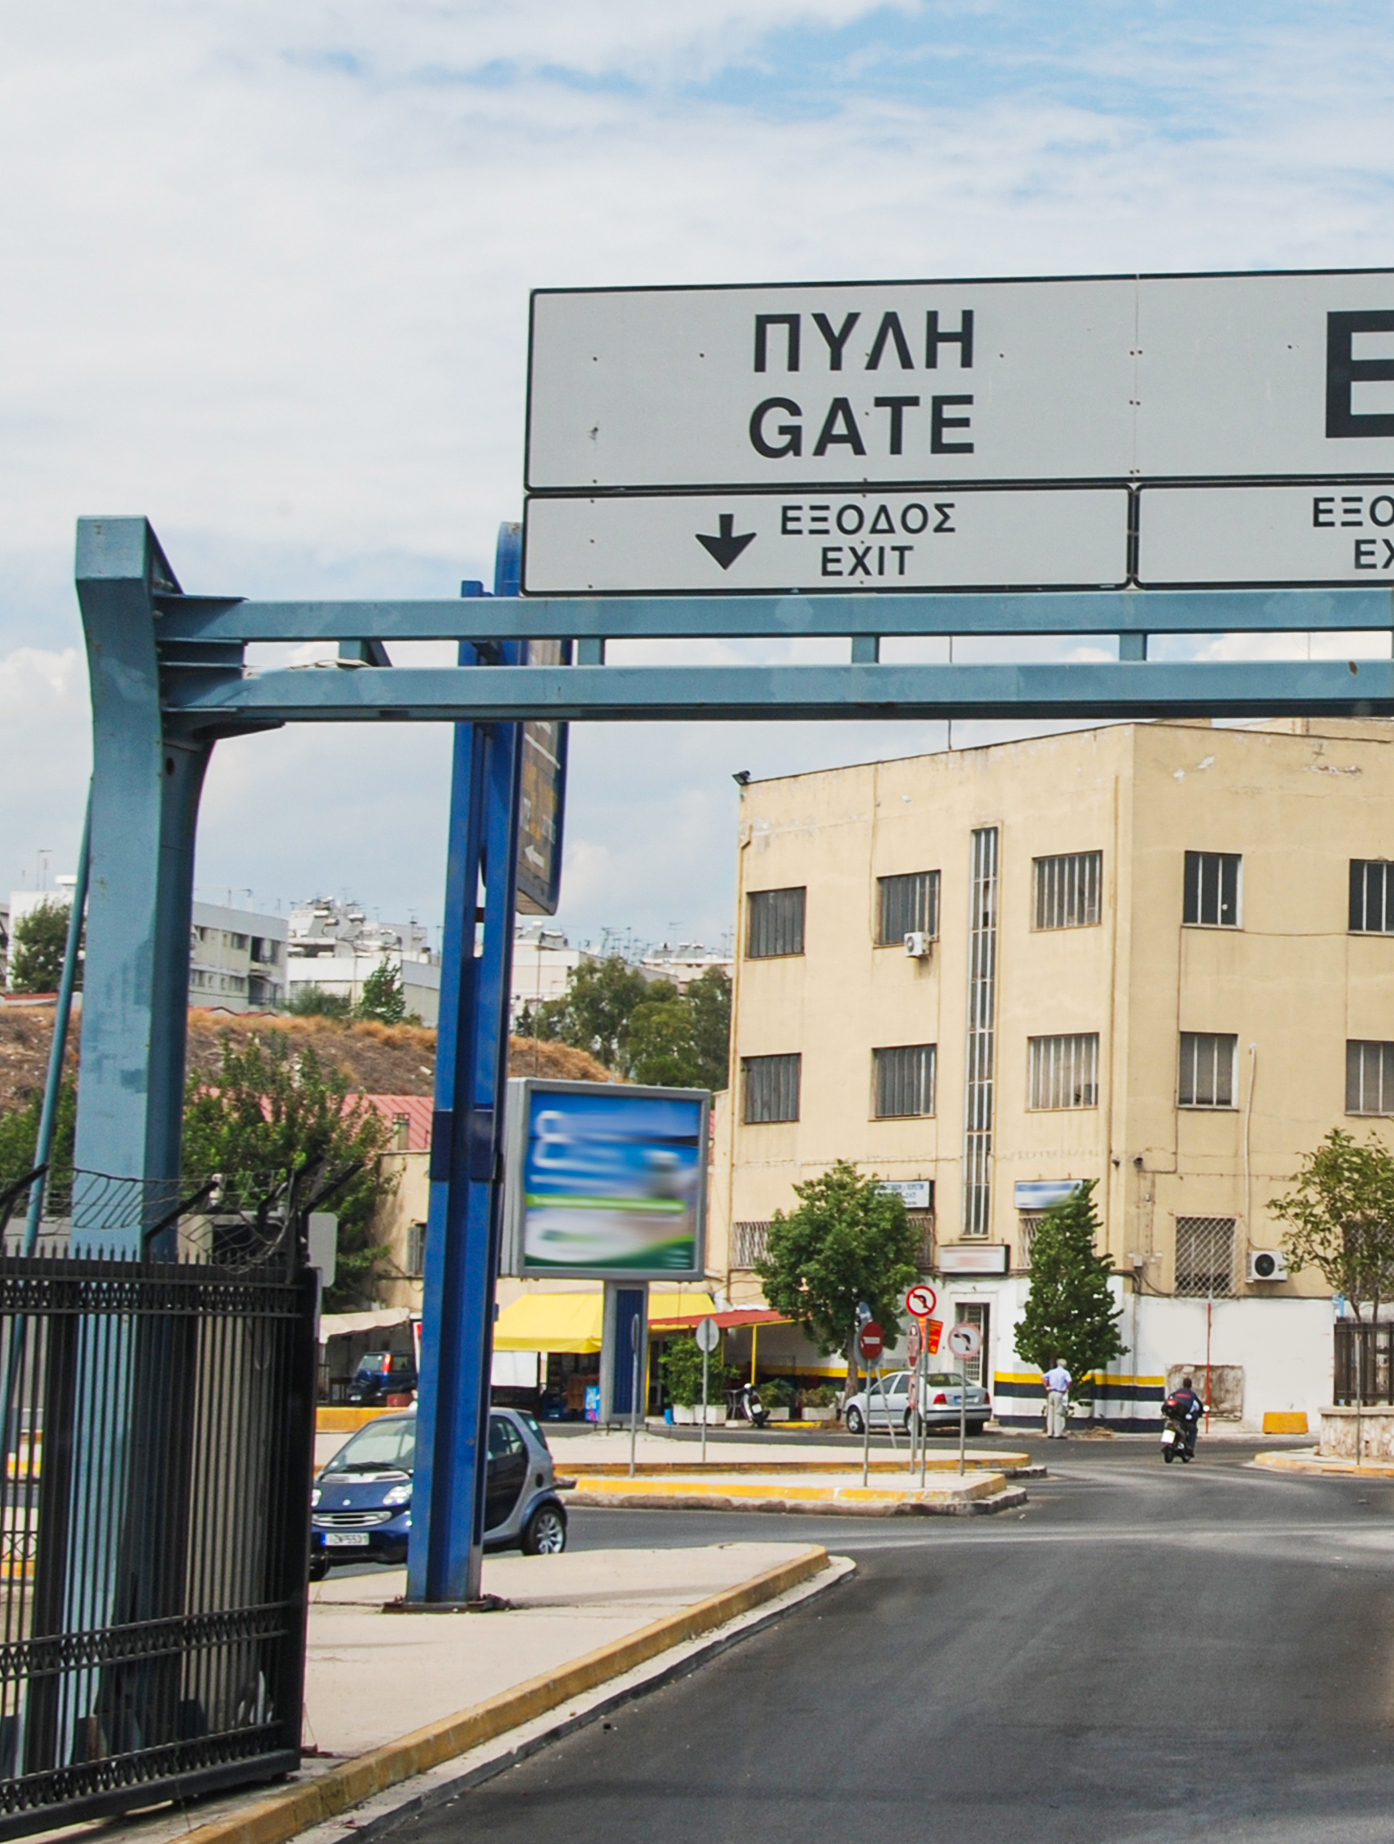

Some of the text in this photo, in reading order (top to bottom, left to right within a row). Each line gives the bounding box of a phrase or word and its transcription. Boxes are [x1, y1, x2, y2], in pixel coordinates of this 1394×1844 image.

[753, 309, 975, 374] ΠΥΛΗ
[748, 395, 976, 460] GATE
[780, 503, 957, 536] ΕΞΟΔΟΣ
[821, 545, 915, 577] EXIT
